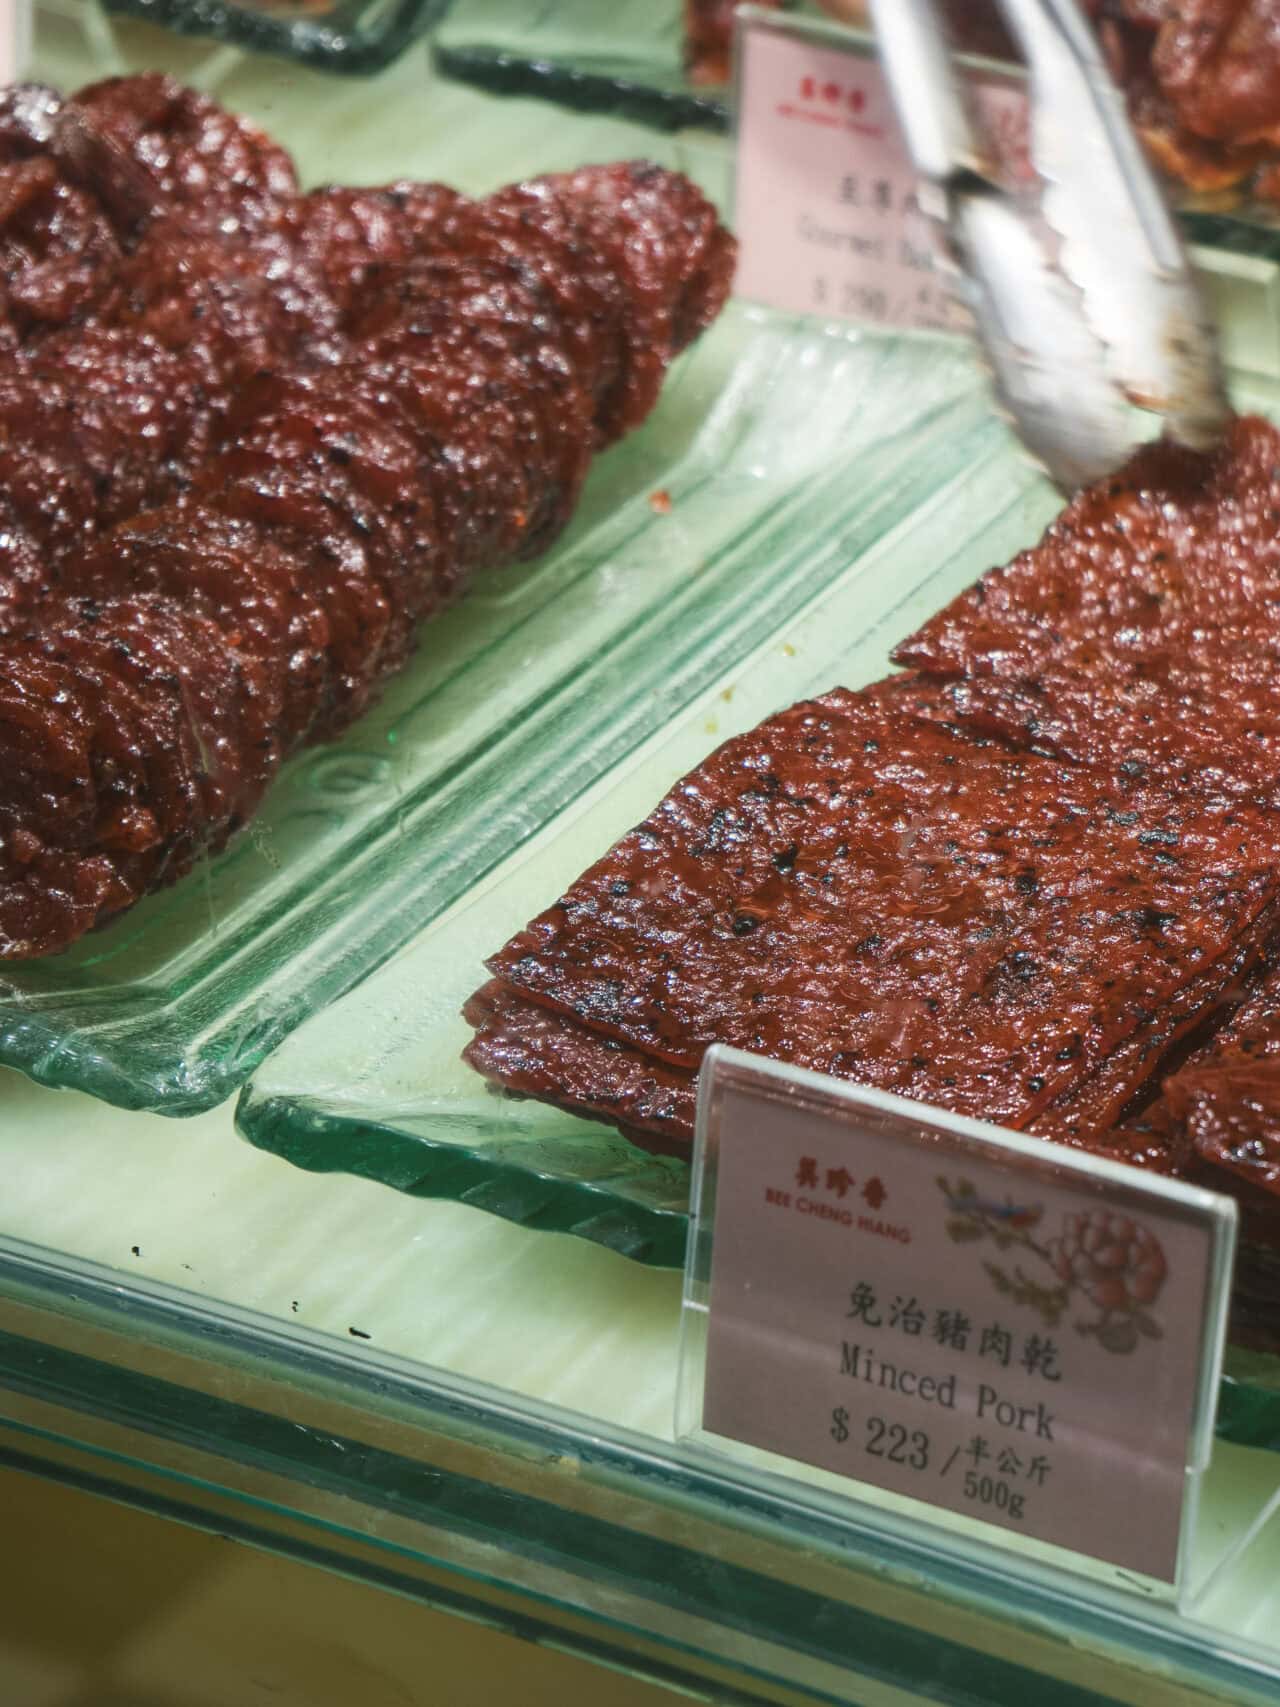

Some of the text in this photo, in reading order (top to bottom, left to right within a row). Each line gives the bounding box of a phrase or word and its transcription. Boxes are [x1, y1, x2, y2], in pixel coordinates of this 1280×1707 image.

[765, 1186, 912, 1244] BEE CHENG HIANG
[846, 1281, 1063, 1382] 免治豬肉乾
[840, 1340, 1056, 1443] Minced Pork
[865, 1416, 930, 1470] 223
[962, 1471, 1027, 1520] 500g
